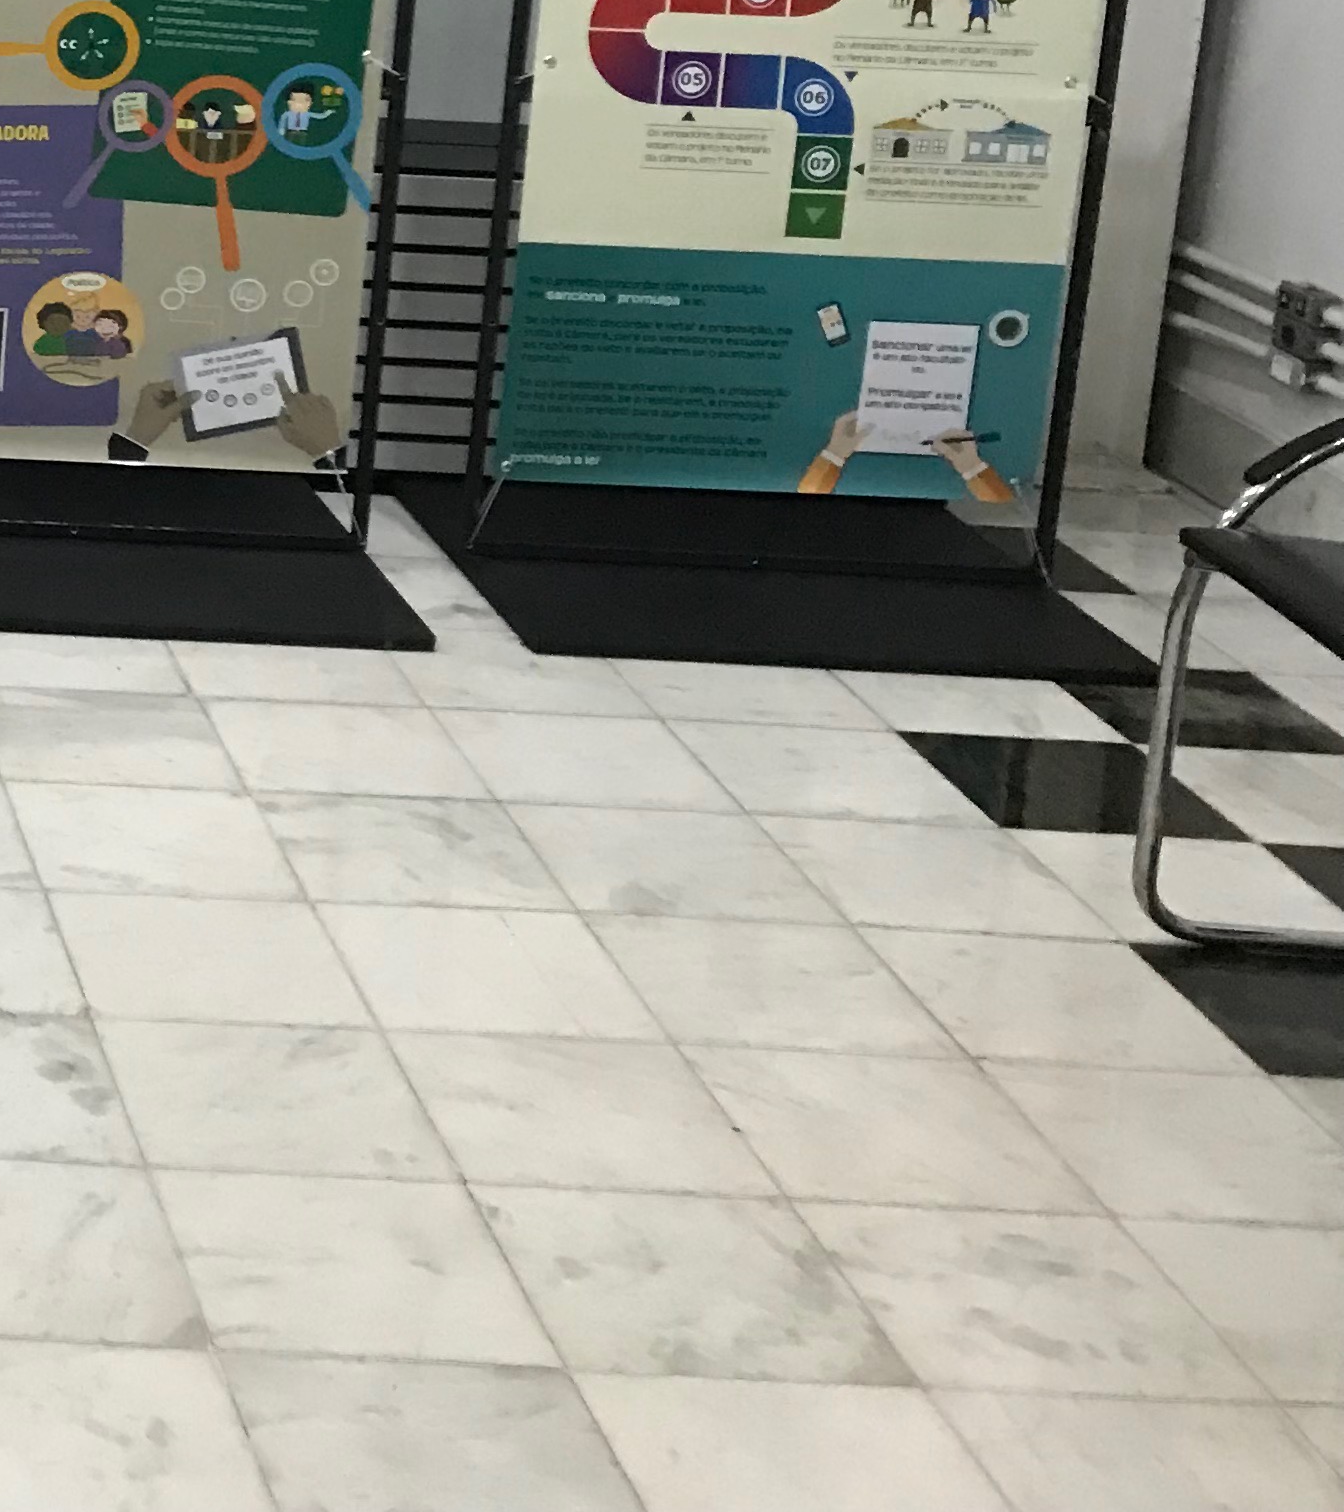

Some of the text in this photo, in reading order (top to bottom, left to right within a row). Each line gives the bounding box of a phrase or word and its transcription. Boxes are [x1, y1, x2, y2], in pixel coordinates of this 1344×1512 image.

[680, 72, 704, 86] 05
[802, 90, 825, 105] 06
[810, 157, 832, 170] 07
